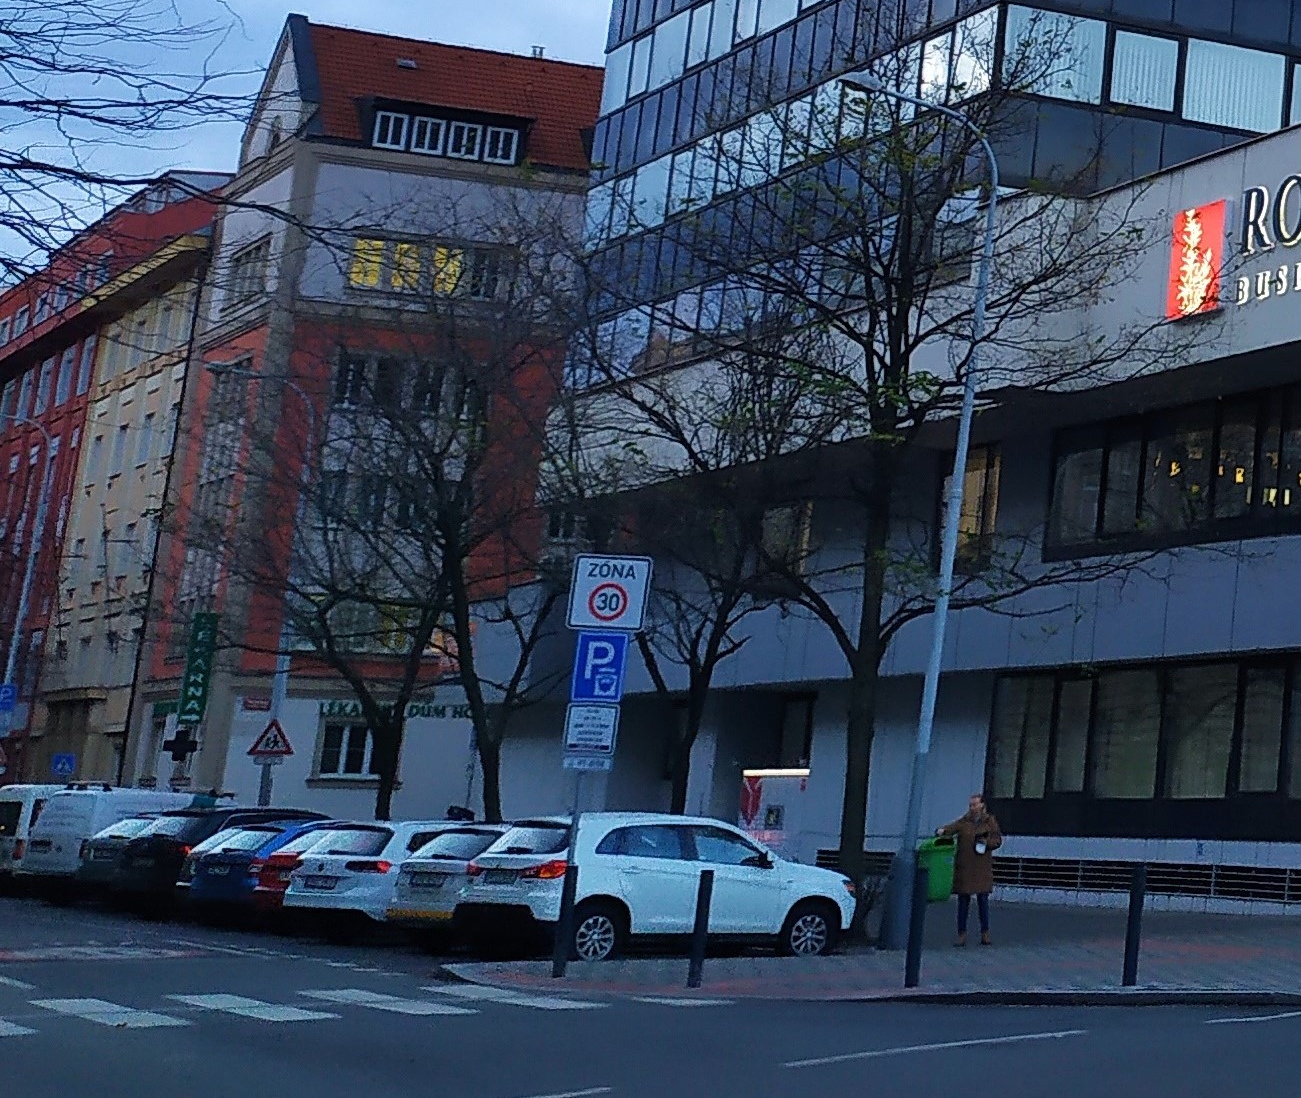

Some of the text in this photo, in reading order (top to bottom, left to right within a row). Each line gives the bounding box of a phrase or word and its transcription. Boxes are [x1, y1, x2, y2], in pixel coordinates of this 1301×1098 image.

[587, 560, 637, 580] ZÓNA
[595, 592, 620, 612] 30
[584, 640, 616, 680] P
